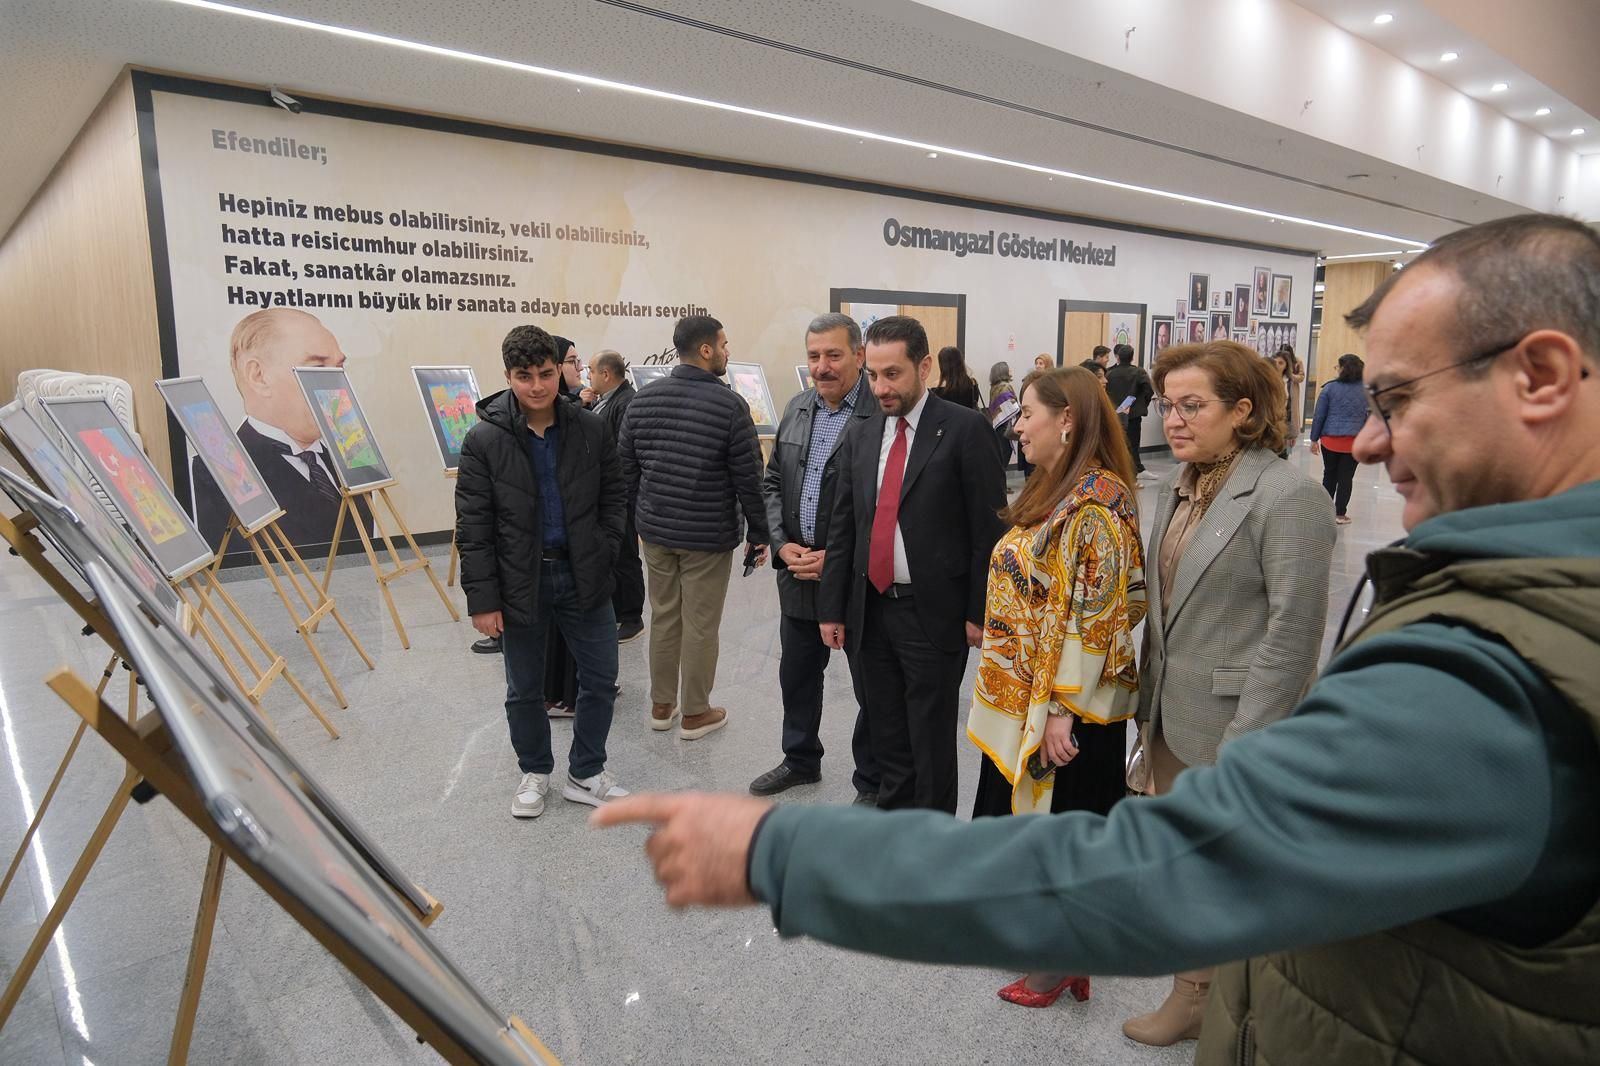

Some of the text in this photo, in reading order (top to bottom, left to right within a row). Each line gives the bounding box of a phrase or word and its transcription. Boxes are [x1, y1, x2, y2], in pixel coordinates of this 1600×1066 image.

[211, 128, 328, 165] Efendiler;
[218, 192, 650, 249] Hepiniz mebus olabilirsiniz, vekil olabilirsiniz,
[221, 224, 534, 263] hatta reisicumhur olabilirsiniz.
[883, 218, 1116, 266] Osmangazi Gösteri Merkezi
[224, 255, 516, 287] Fakat, sanatkâr olamazsınız.
[227, 286, 712, 318] Hayatlarını büyük bir sanata adayan çocukları sevelim.
